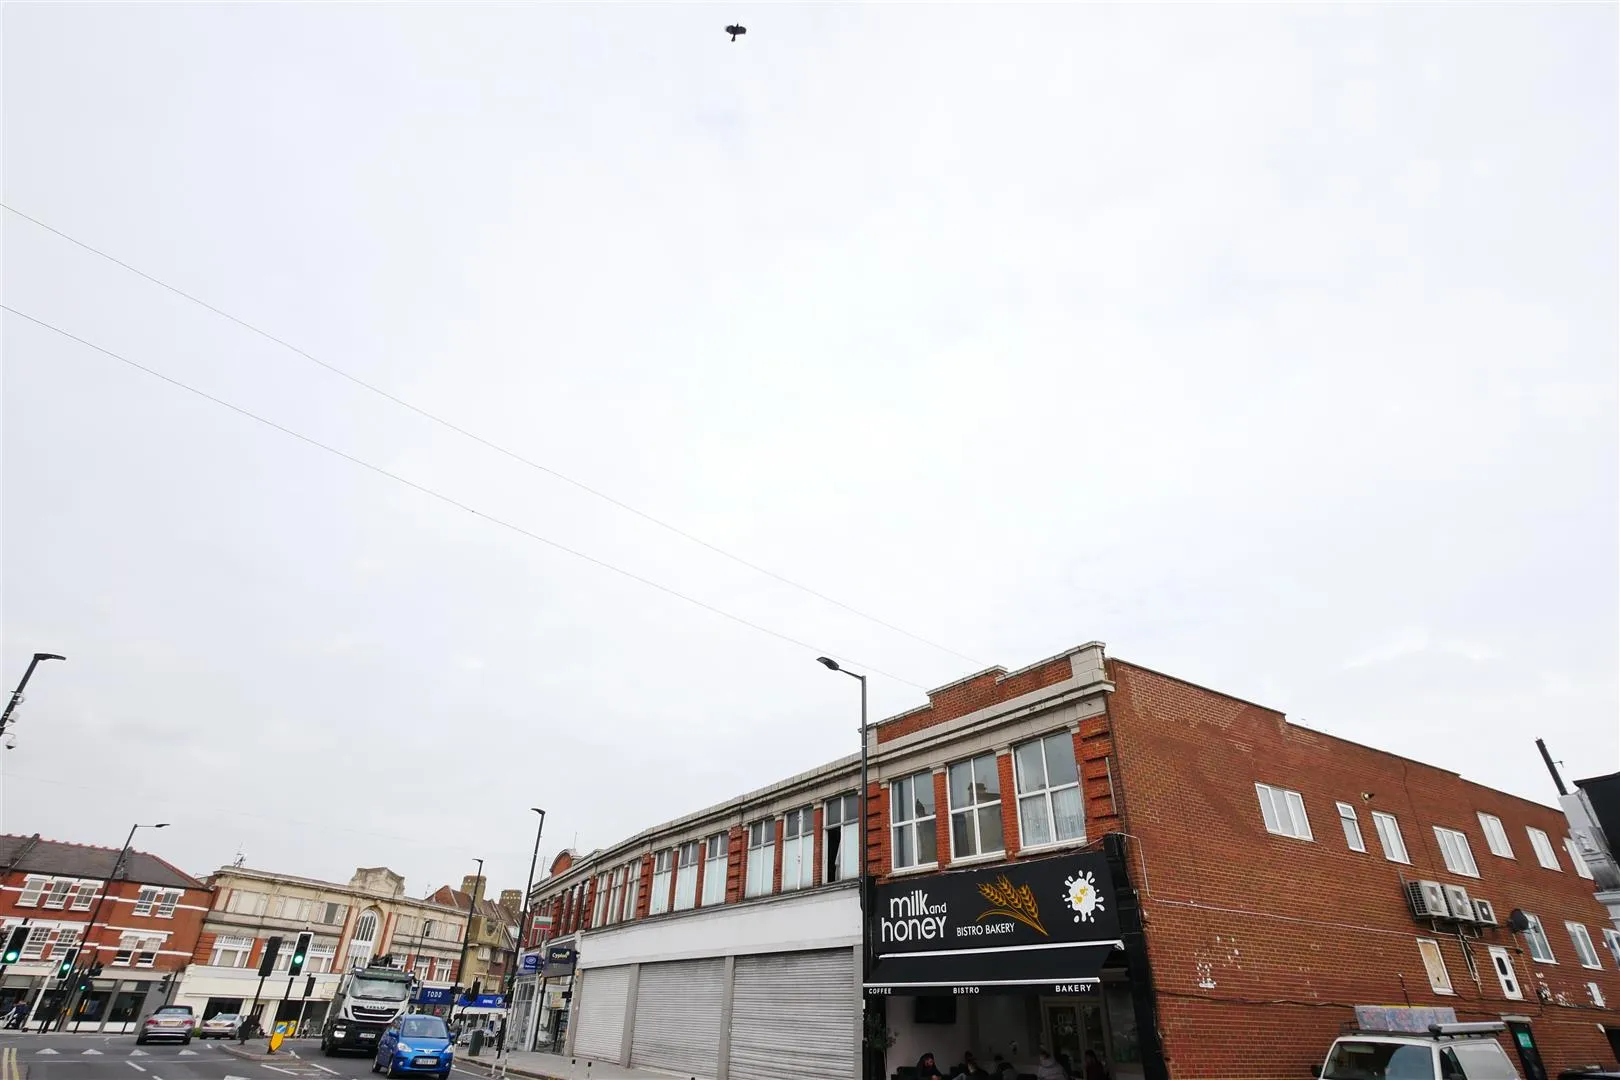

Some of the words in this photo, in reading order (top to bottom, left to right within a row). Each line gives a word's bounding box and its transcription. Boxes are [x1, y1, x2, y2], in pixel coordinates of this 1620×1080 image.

[890, 889, 929, 918] milk
[929, 902, 947, 914] and
[956, 925, 984, 937] BISTRO
[985, 922, 1015, 935] BAKERY
[427, 990, 442, 998] TODD
[868, 987, 892, 995] COFFEE
[953, 986, 980, 994] BISTRO
[1055, 984, 1092, 993] BAKERY
